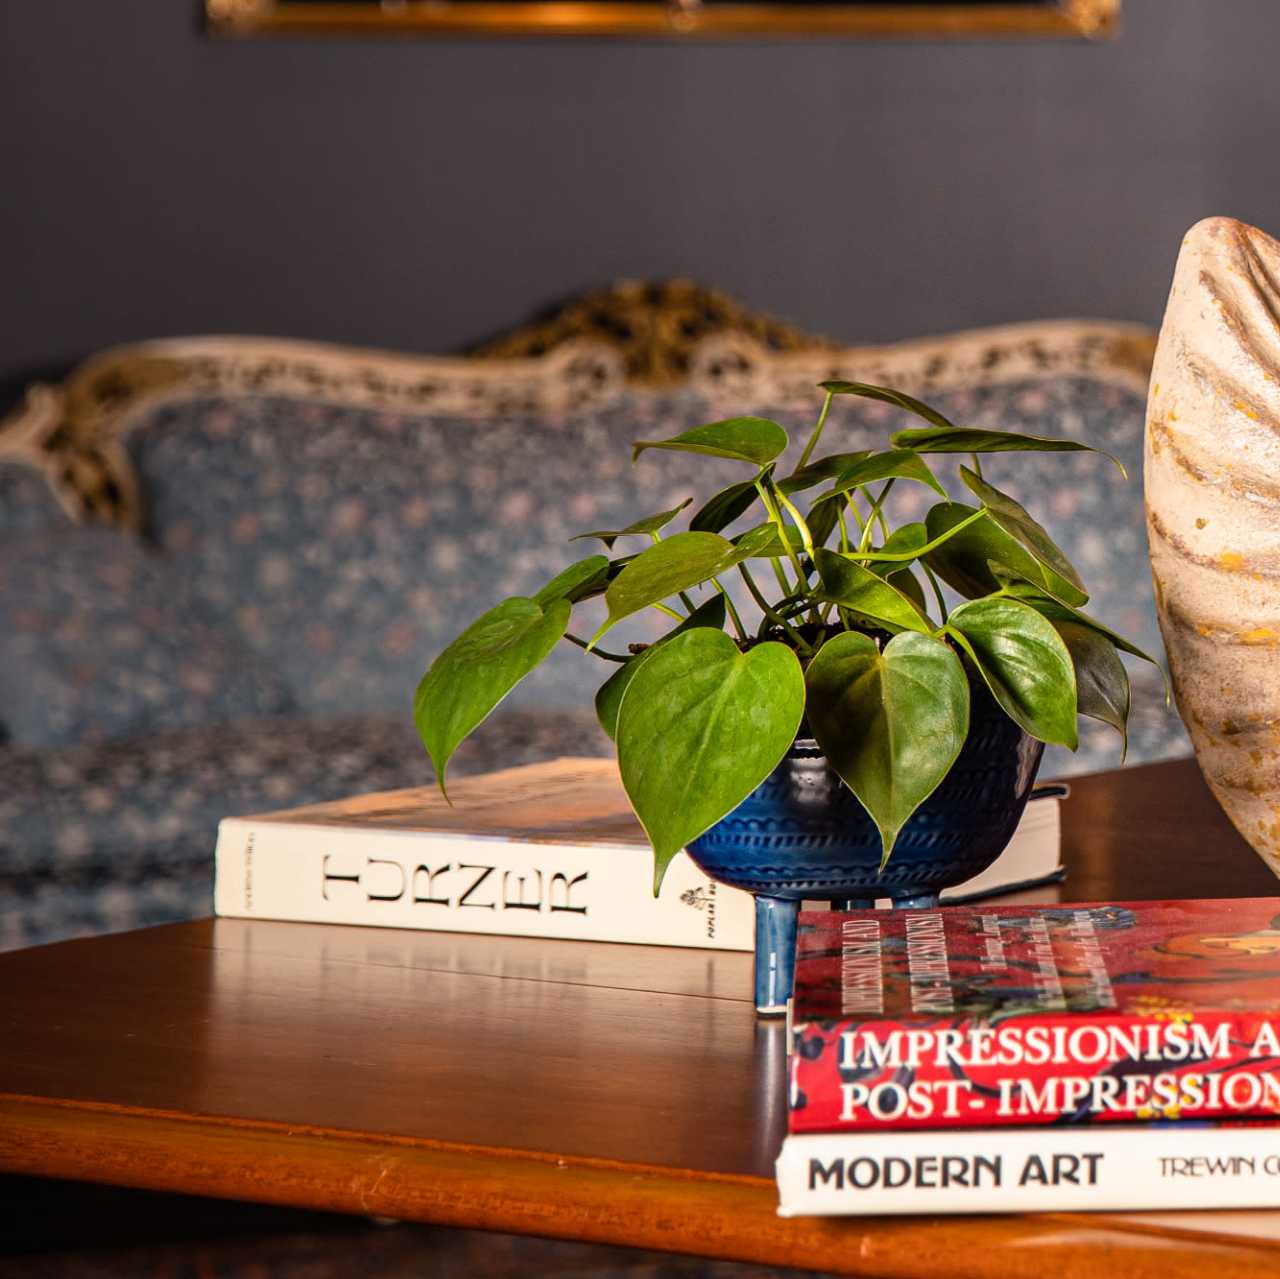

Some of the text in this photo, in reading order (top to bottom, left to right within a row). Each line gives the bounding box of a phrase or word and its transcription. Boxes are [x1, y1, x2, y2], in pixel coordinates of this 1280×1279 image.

[321, 853, 590, 916] TURNER
[841, 919, 881, 939] AND
[839, 1022, 1232, 1069] IMPRESSIONISM
[807, 1152, 1105, 1191] MODERN ART
[1159, 1154, 1256, 1178] TREWIN
